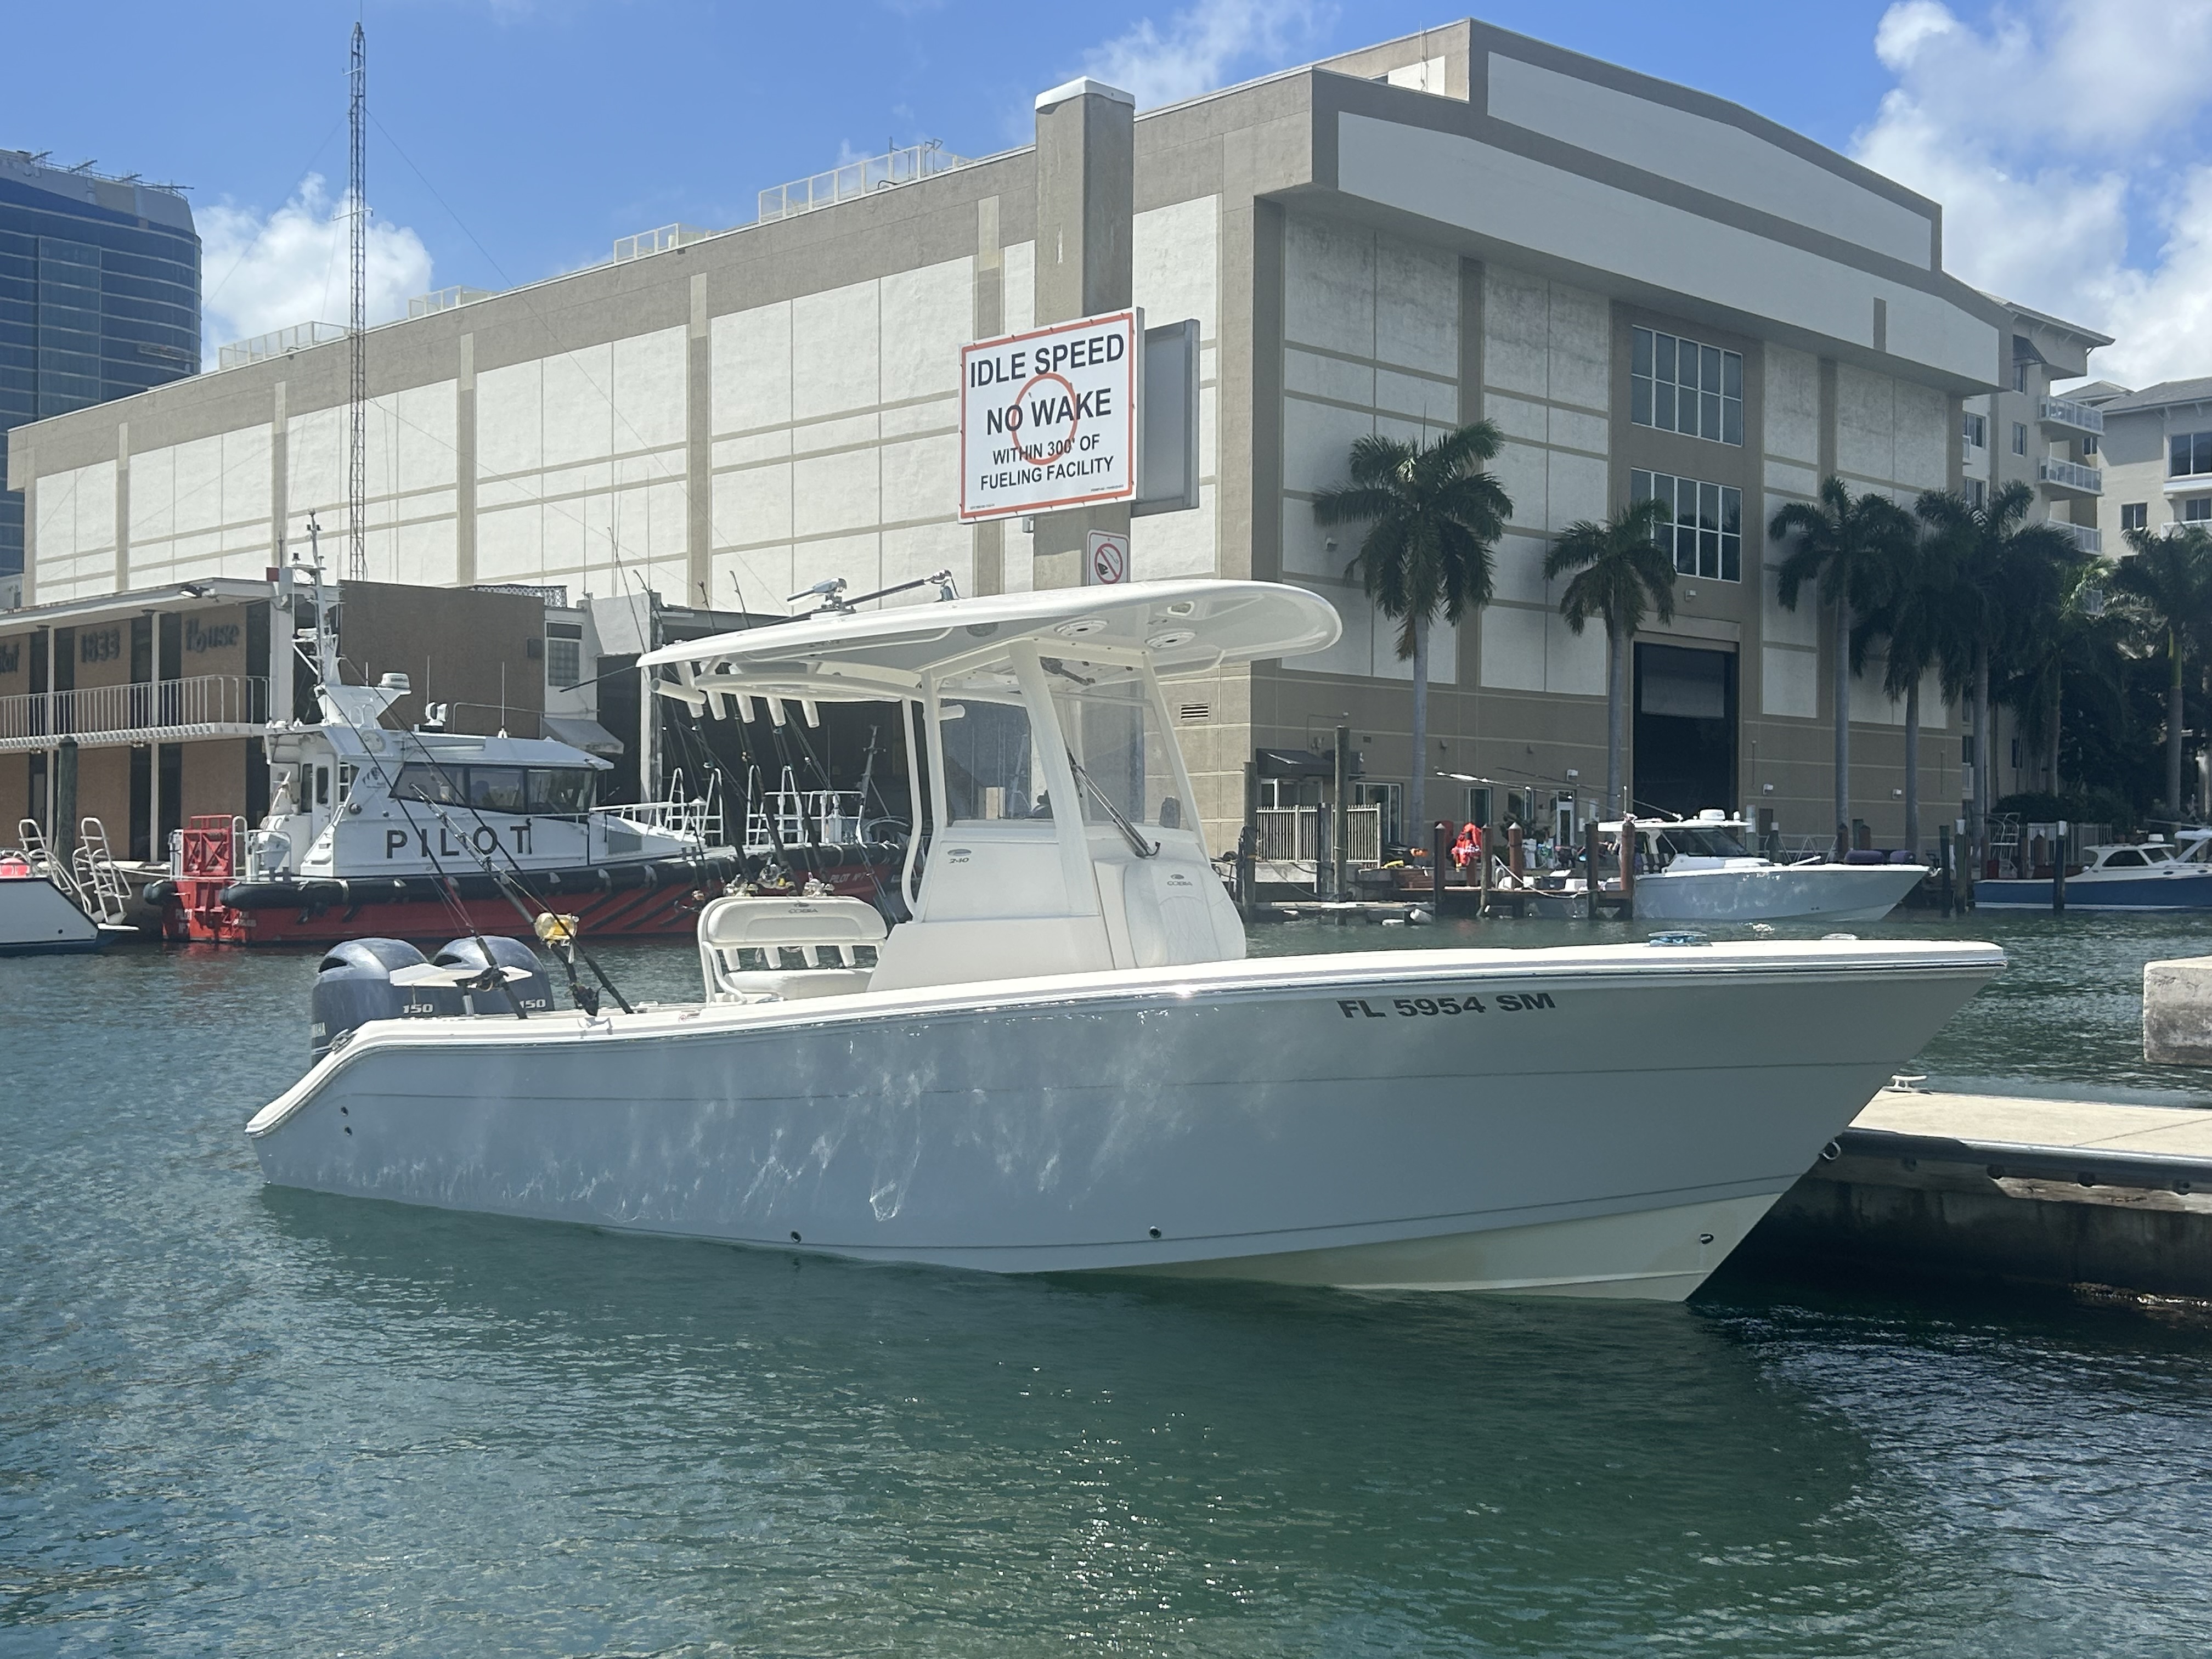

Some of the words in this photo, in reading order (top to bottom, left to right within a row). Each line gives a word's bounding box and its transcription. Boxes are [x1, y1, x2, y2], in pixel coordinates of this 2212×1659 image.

[970, 352, 1026, 388] IDLE
[1035, 334, 1124, 375] SPEED
[988, 404, 1023, 435] NO
[1031, 388, 1111, 427] WAKE
[993, 443, 1042, 465] WITHIN
[1080, 433, 1100, 452] OF
[981, 467, 1042, 490] FUELING
[1047, 455, 1114, 481] FACILITY
[185, 618, 240, 652] House
[387, 826, 531, 859] PILOT
[402, 1003, 433, 1014] 150
[520, 999, 546, 1008] 150
[1336, 1000, 1387, 1018] FL
[1393, 996, 1486, 1017] 5954
[1496, 993, 1556, 1012] SM
